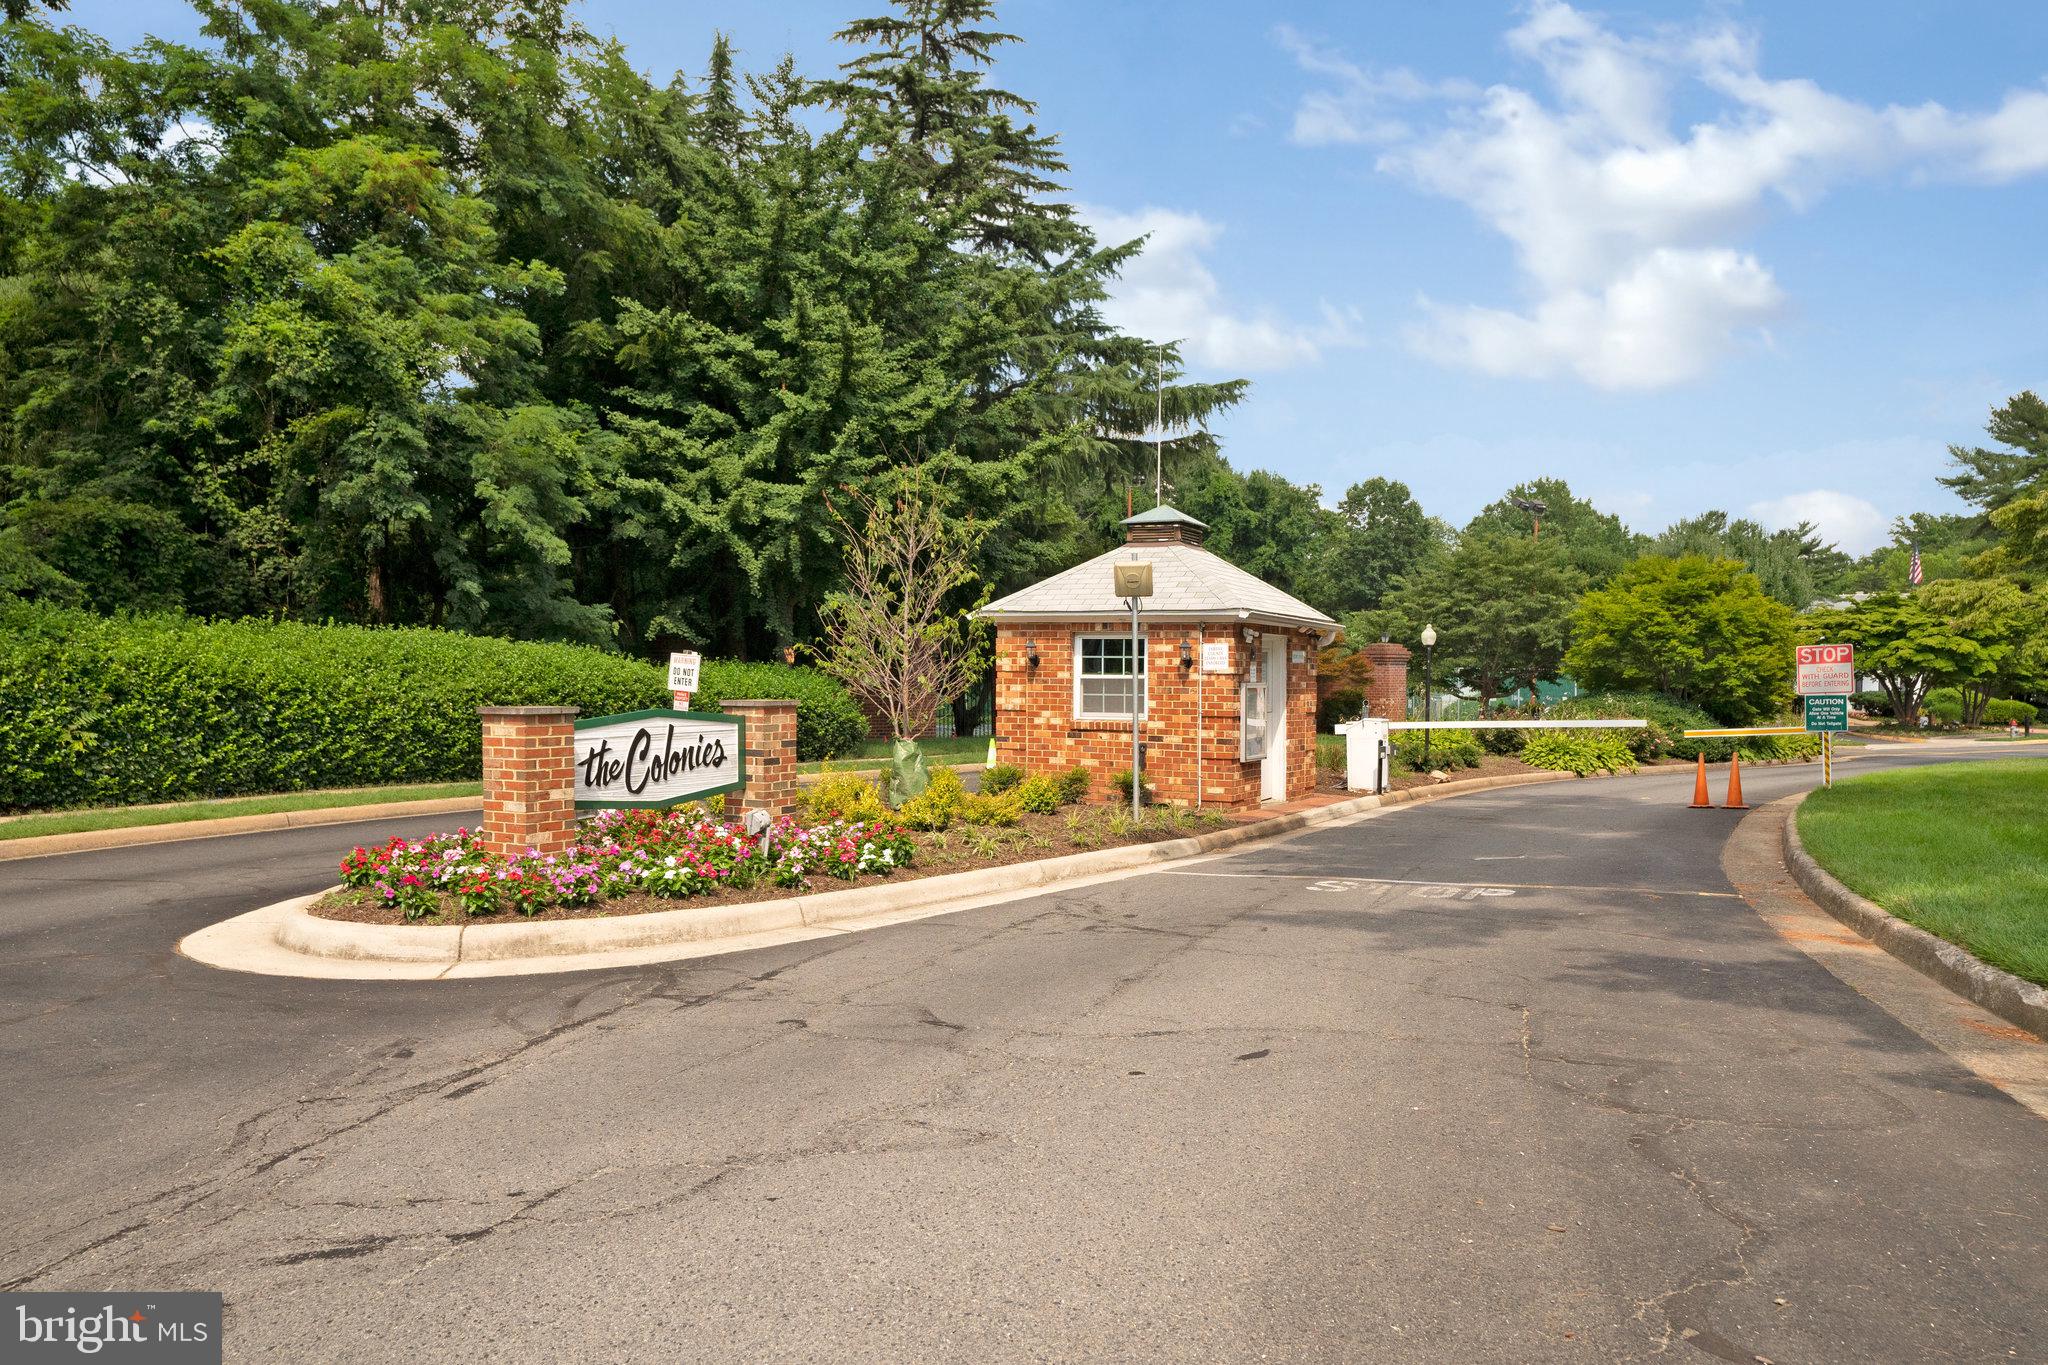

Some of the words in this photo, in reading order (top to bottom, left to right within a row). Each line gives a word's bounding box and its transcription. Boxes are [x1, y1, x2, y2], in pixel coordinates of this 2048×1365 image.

[1800, 647, 1849, 663] STOP
[673, 667, 681, 676] DO
[682, 668, 694, 677] NOT
[674, 677, 692, 687] ENTER
[577, 739, 625, 788] the
[624, 724, 728, 795] Colonies
